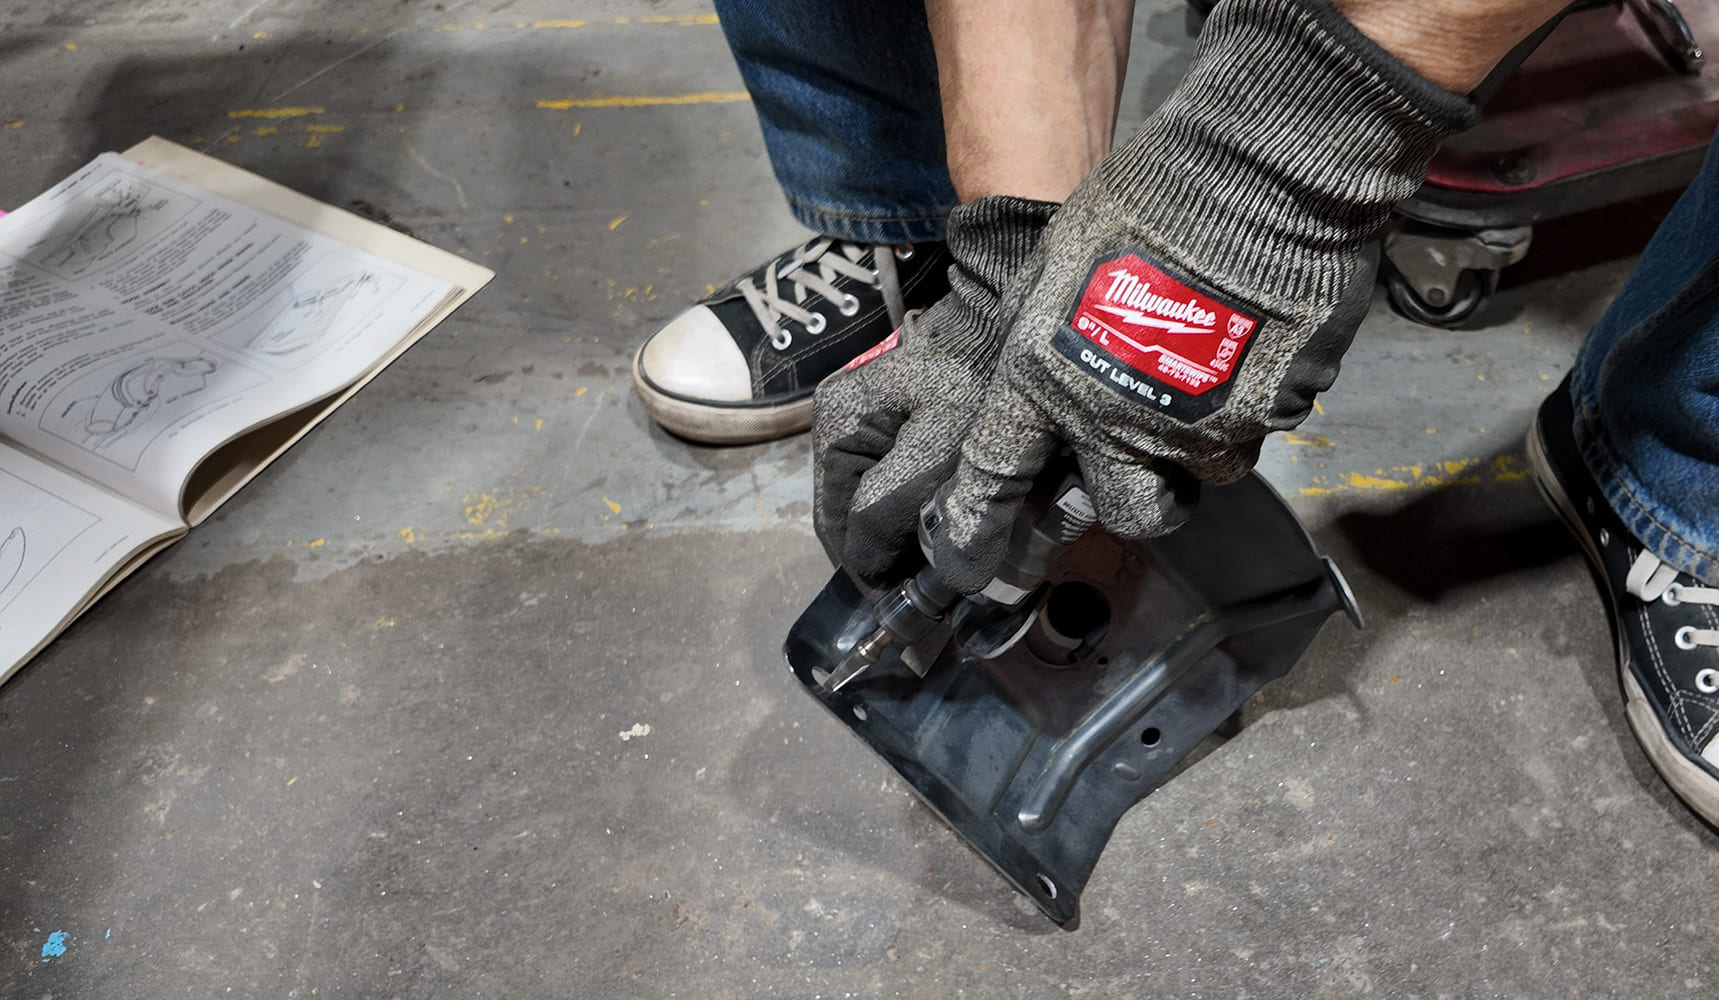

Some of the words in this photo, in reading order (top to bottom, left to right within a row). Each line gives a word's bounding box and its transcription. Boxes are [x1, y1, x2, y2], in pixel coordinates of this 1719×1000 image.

[1107, 268, 1216, 327] Milwaukee
[1080, 348, 1112, 374] CUT
[1110, 368, 1157, 401] LEVEL
[1159, 392, 1173, 407] 3
